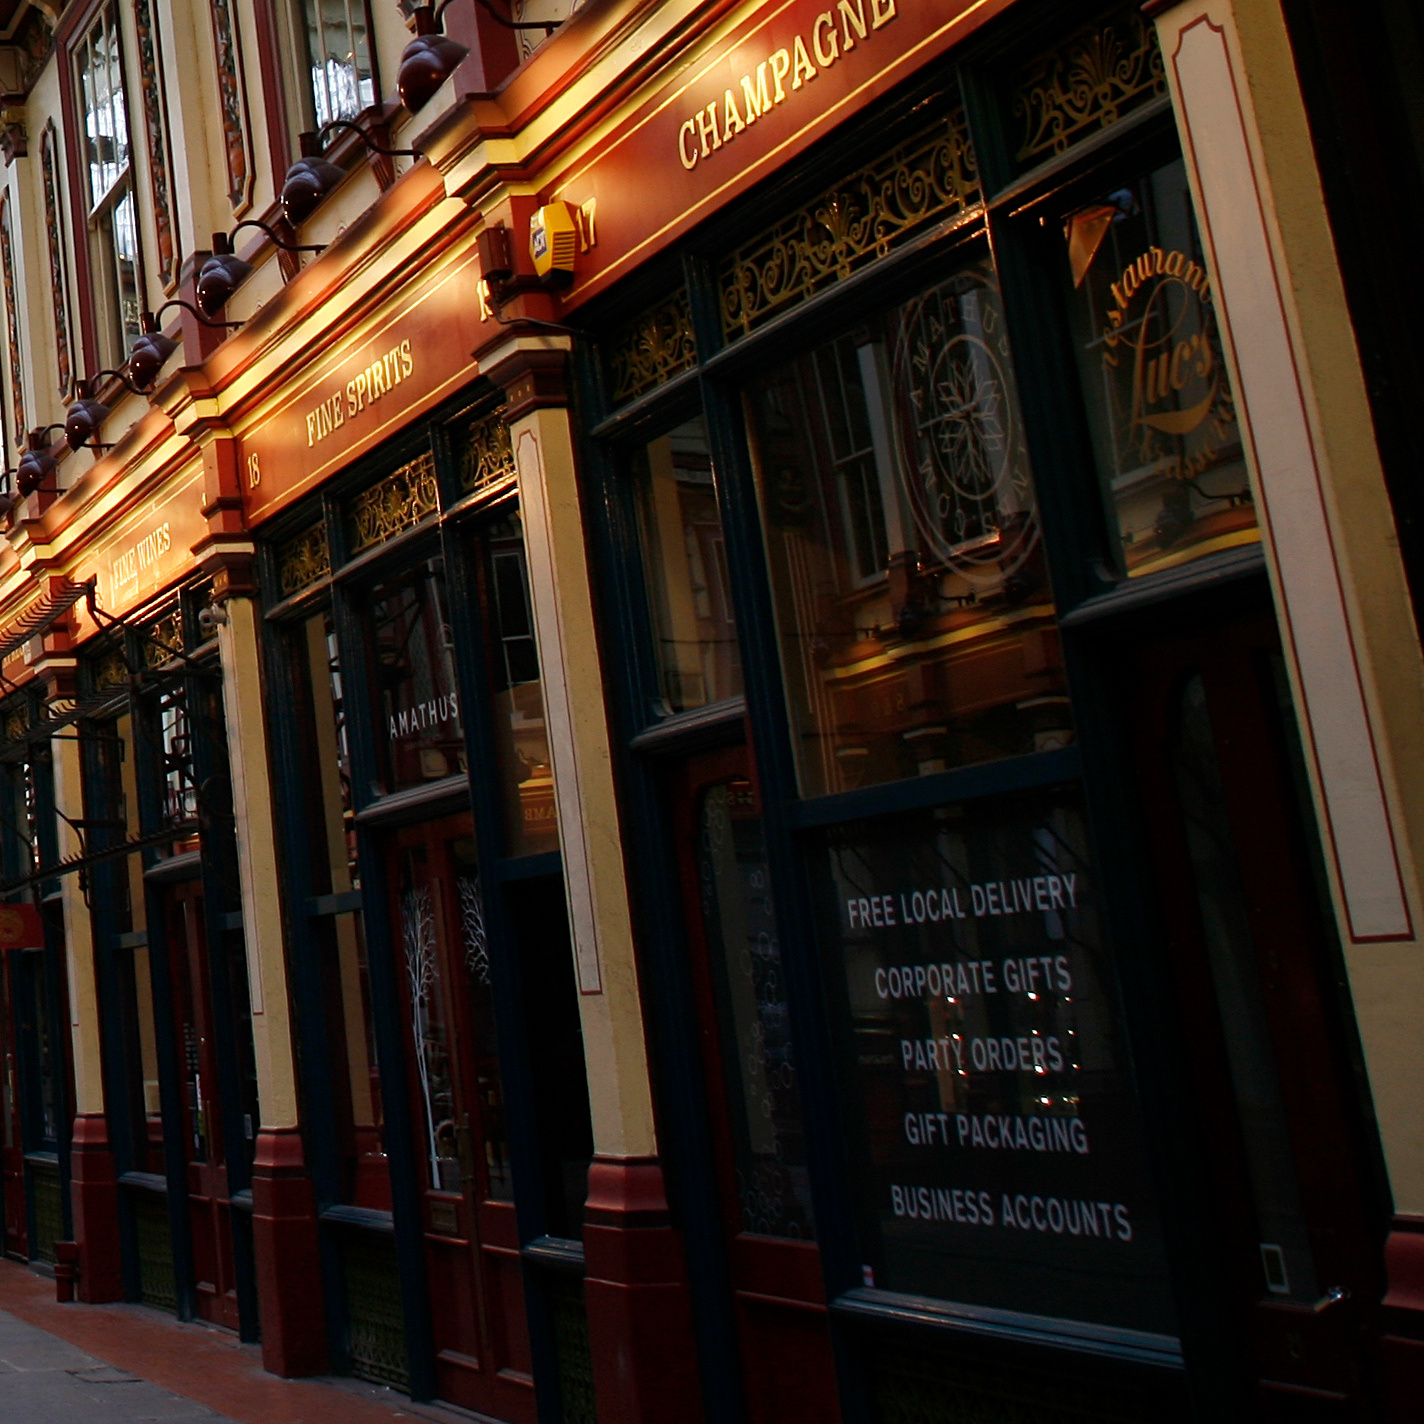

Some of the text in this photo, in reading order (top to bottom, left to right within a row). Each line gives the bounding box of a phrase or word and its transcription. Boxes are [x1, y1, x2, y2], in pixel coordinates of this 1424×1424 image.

[575, 196, 597, 253] 17
[305, 339, 414, 448] FINE SPIRITS
[247, 452, 261, 489] 18
[112, 522, 171, 591] FINE WINES
[389, 692, 458, 740] AMATHUS
[847, 873, 1078, 929] FREE LOCAL DELIVERY
[875, 955, 1072, 999] CORPORATE GIFTS
[900, 1037, 1064, 1073] PARTY ORDERS
[904, 1112, 1091, 1156] GIFT PACKAGING
[890, 1183, 1132, 1243] BUSINESS ACCOUNTS
